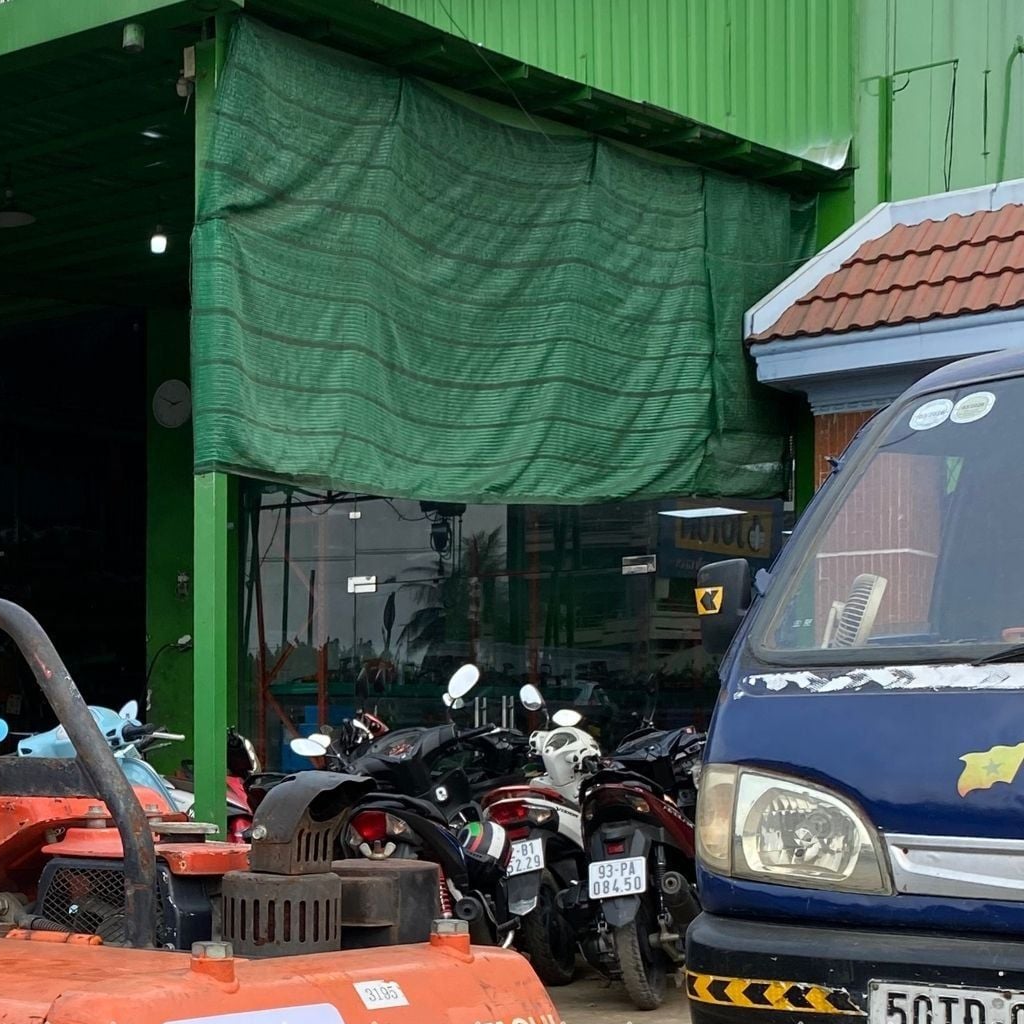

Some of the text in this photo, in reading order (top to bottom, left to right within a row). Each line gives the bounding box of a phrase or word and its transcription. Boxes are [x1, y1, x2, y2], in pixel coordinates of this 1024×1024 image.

[598, 862, 636, 879] 93-PA
[593, 875, 642, 896] 084.50
[364, 985, 399, 1002] 3195
